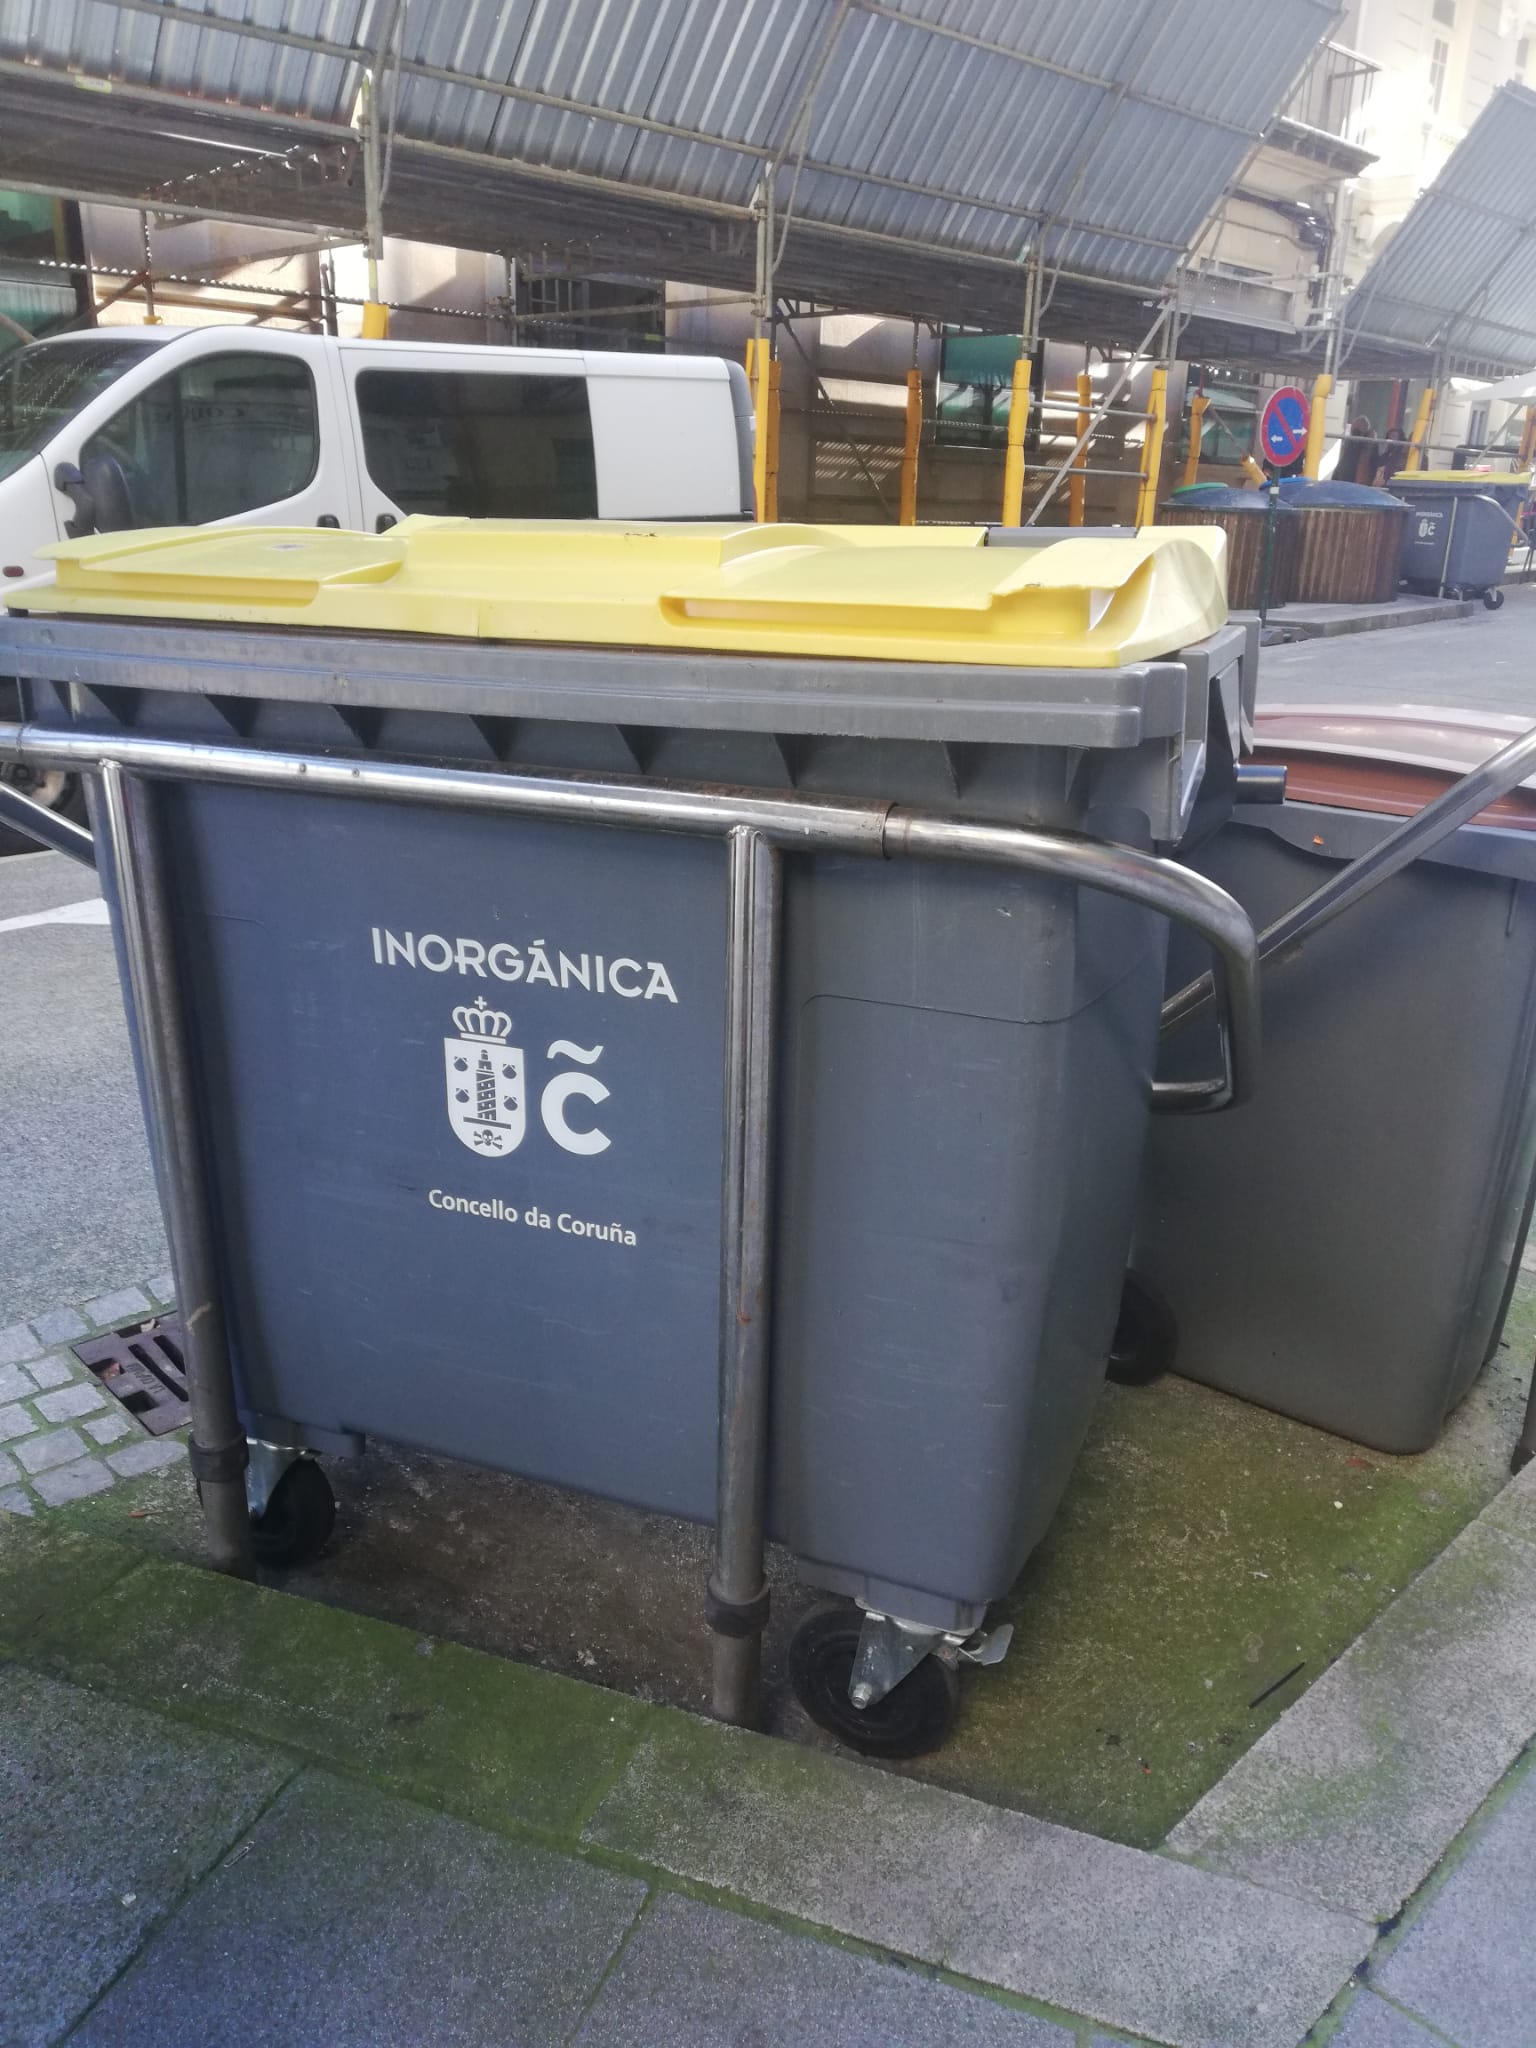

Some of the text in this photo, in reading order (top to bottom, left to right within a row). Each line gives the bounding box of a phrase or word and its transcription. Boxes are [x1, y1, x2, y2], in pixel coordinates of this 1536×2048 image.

[371, 927, 679, 1004] INORGÁNICA
[428, 1189, 637, 1247] Concello da Coruña
